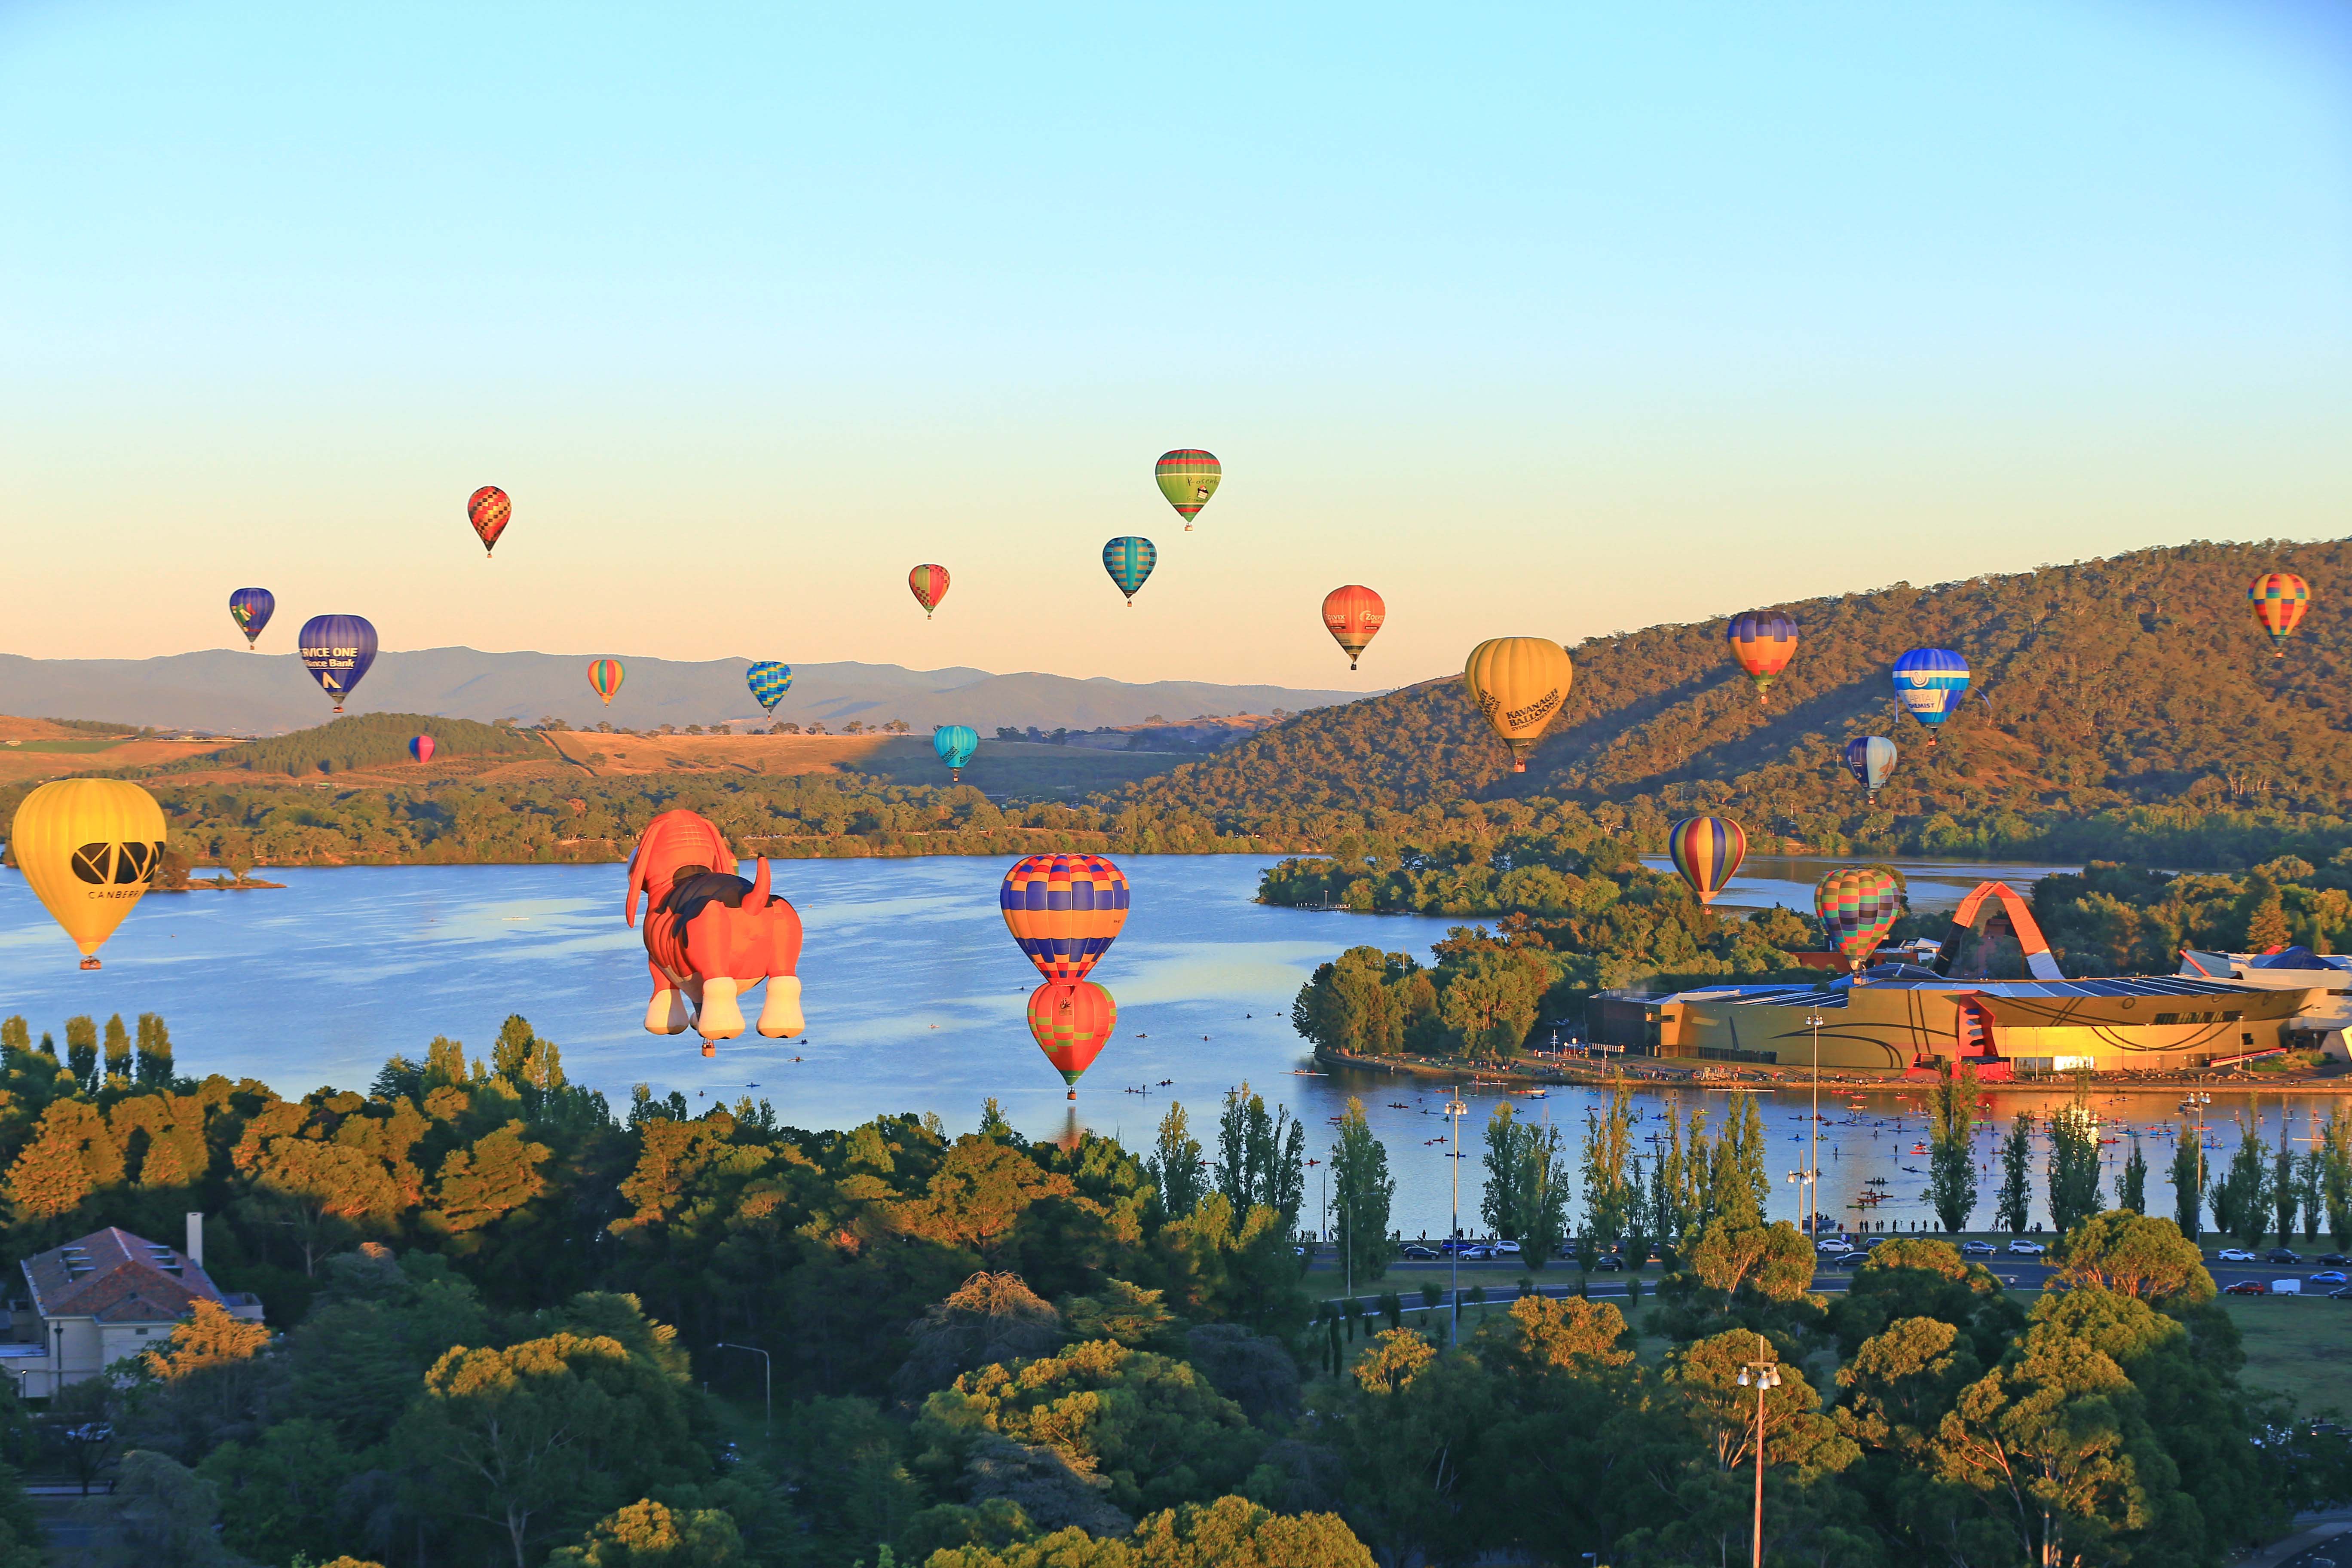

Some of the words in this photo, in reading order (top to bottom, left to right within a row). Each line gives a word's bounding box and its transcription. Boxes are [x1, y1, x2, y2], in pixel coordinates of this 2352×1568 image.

[333, 647, 358, 657] ONE
[329, 658, 355, 667] Bank
[1506, 688, 1558, 719] KAVANAGH
[1509, 695, 1559, 726] BALLOONS
[1511, 721, 1533, 731] SYDNEY
